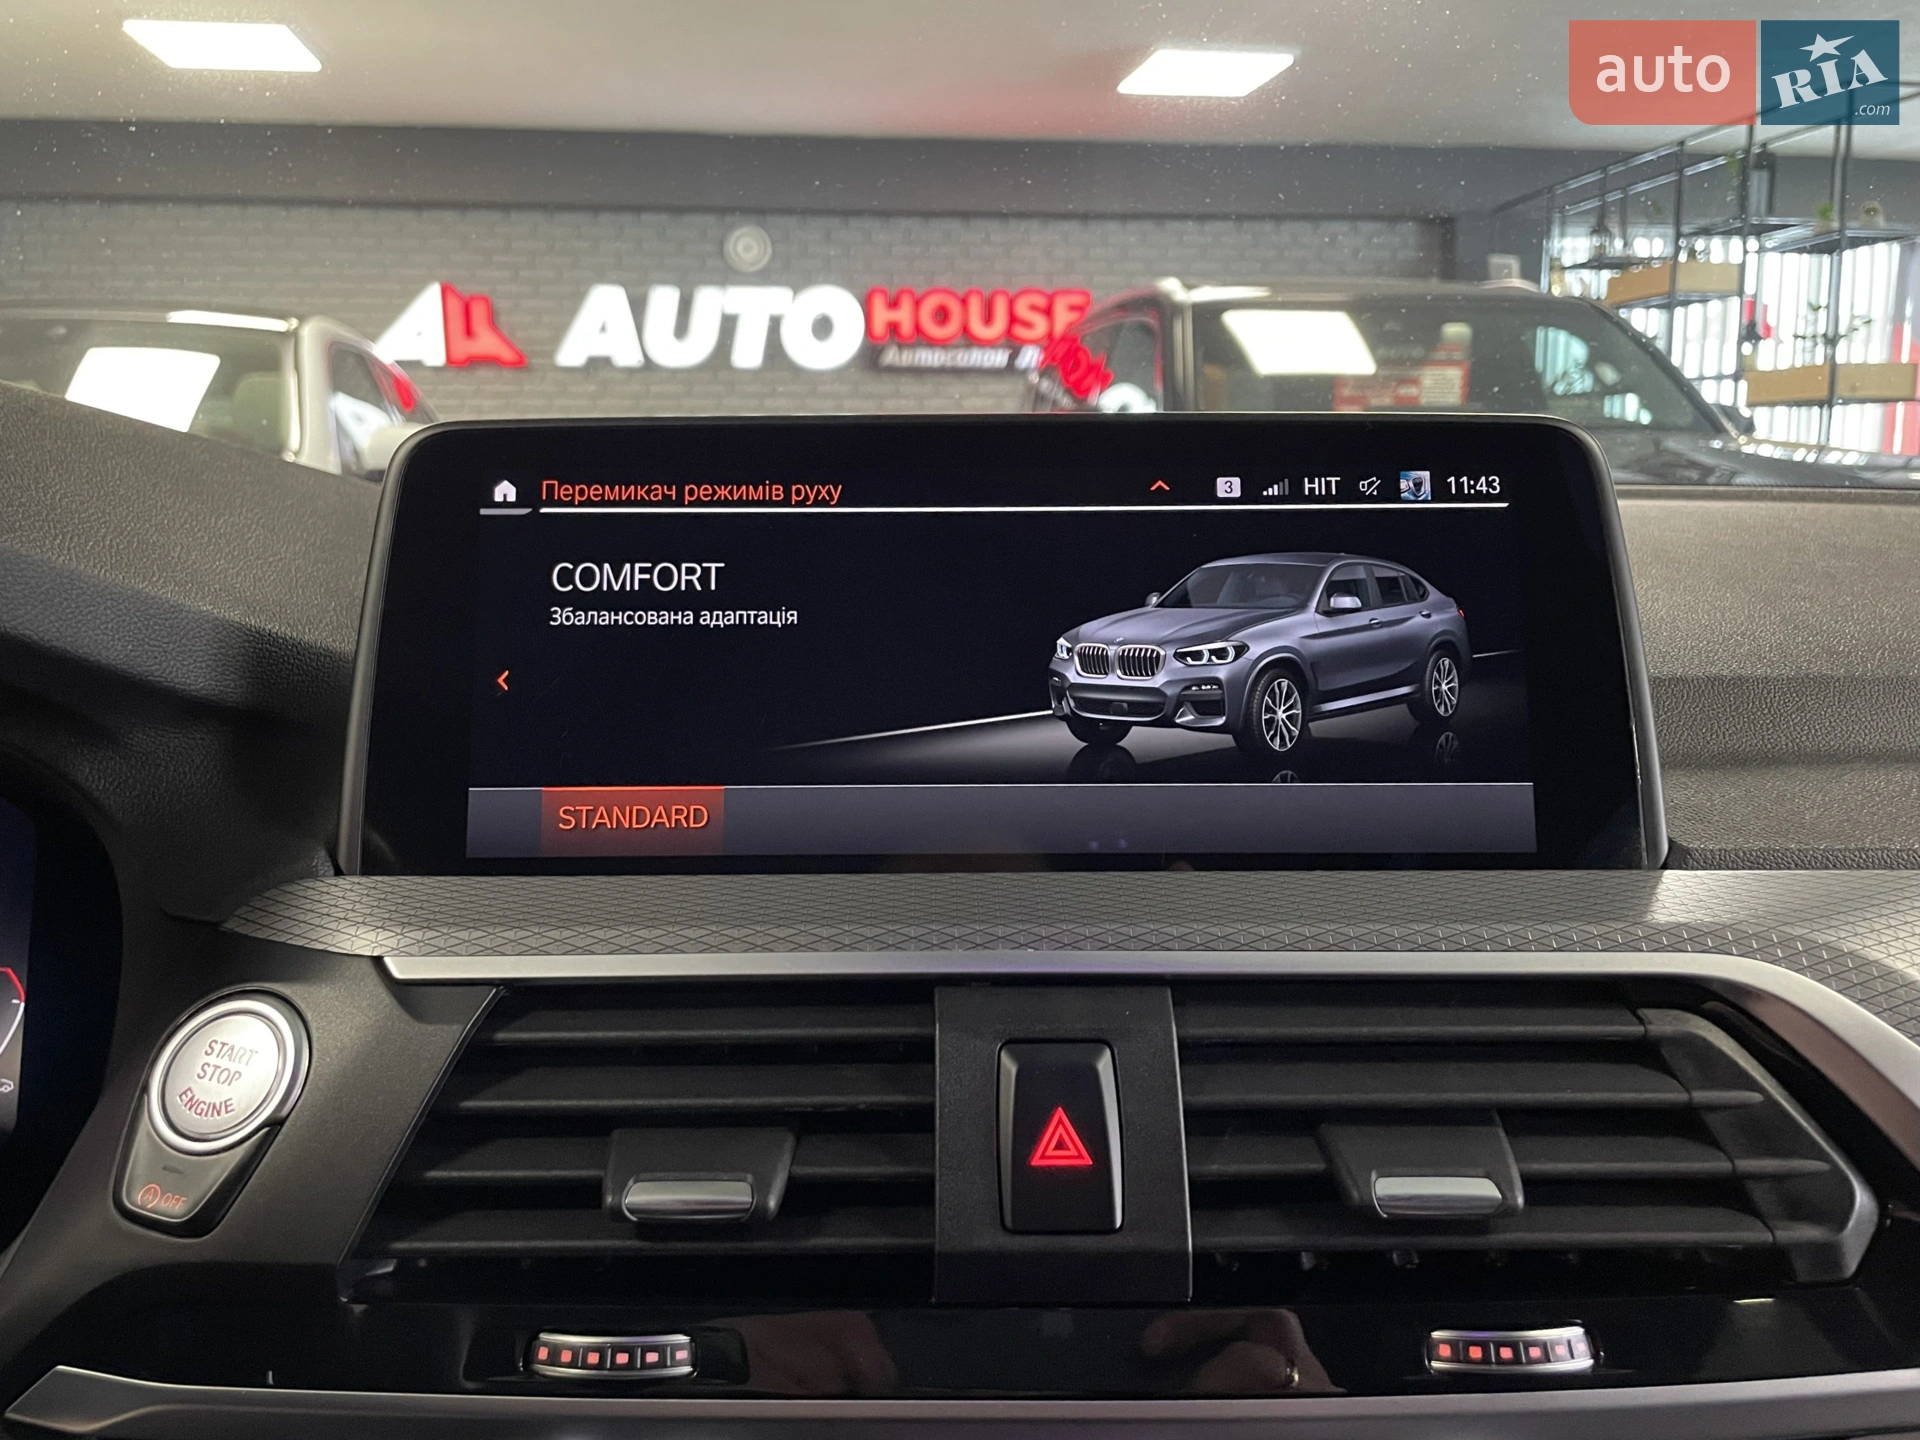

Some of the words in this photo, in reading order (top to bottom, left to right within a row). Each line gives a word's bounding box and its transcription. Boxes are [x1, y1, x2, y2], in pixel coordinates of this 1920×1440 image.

[554, 284, 865, 369] AUTO
[867, 287, 1091, 343] HOUSE
[541, 480, 677, 504] Перемикач
[684, 480, 784, 505] режимів
[791, 483, 843, 505] руху
[1223, 480, 1234, 495] 3
[1304, 477, 1341, 496] HIT
[1447, 476, 1501, 495] 11:43
[551, 562, 726, 592] COMFORT
[549, 606, 694, 626] Збалансована
[699, 606, 798, 627] адаптація
[557, 804, 709, 830] STANDARD
[204, 1039, 259, 1066] START
[196, 1061, 242, 1087] STOP
[176, 1086, 235, 1119] ENGINE
[161, 1193, 187, 1209] OFF
